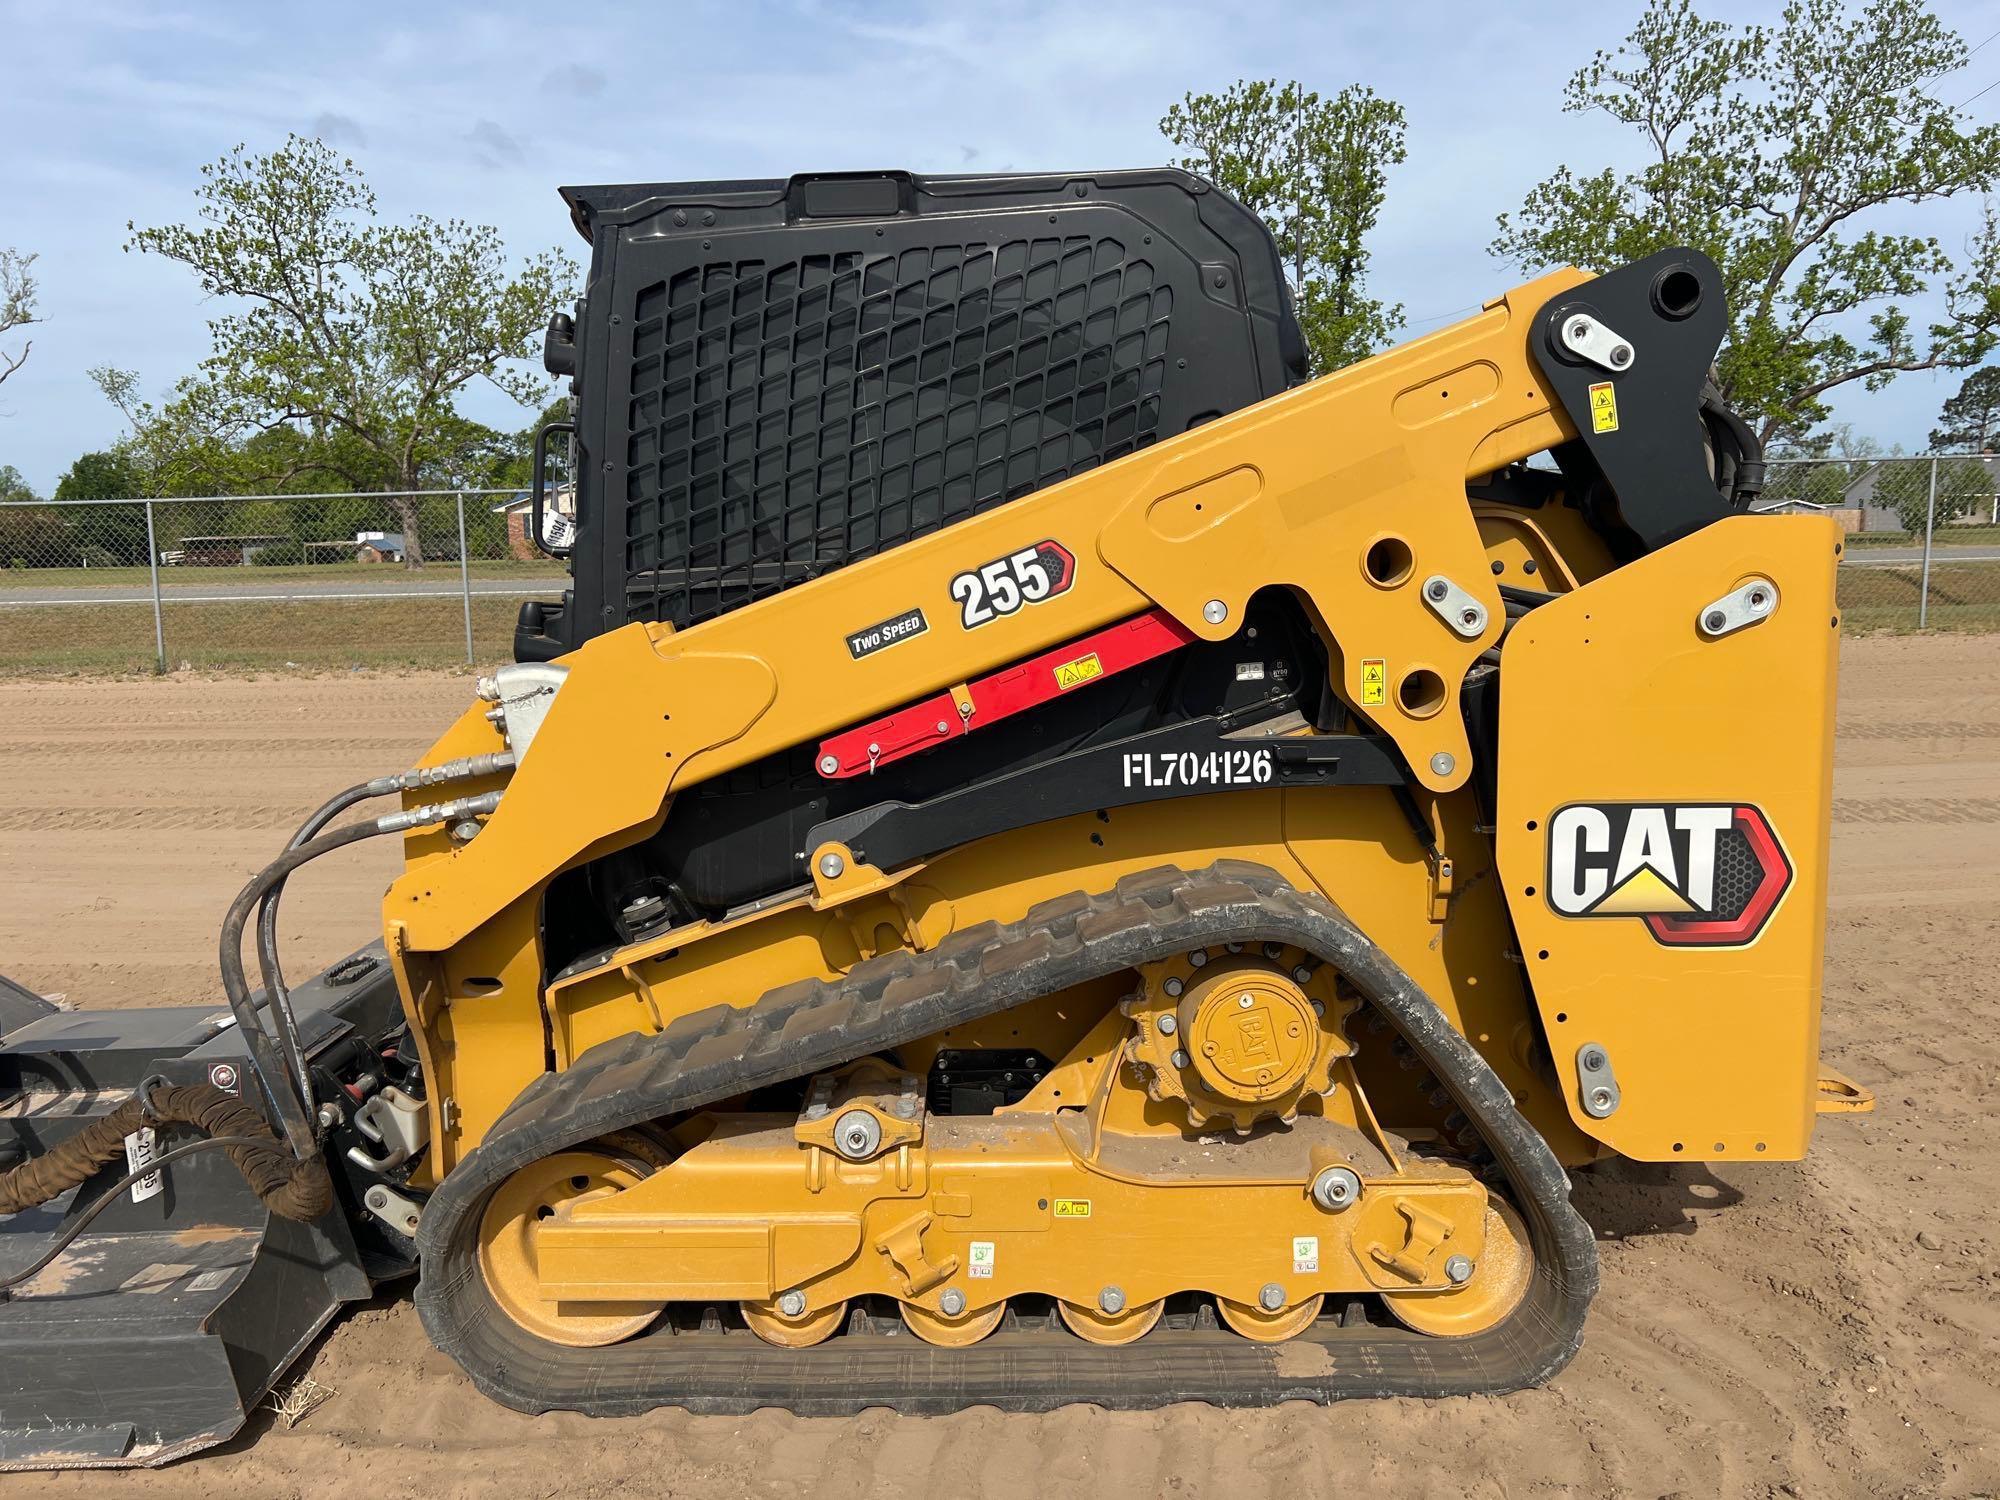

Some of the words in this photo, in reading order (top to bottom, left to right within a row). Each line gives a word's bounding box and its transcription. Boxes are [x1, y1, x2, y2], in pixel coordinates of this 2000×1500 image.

[952, 548, 1050, 627] 255
[852, 632, 880, 653] TWO
[882, 616, 920, 641] SPEED
[1123, 750, 1272, 787] FL704126
[1551, 806, 1732, 913] CAT
[138, 1141, 157, 1189] 21195
